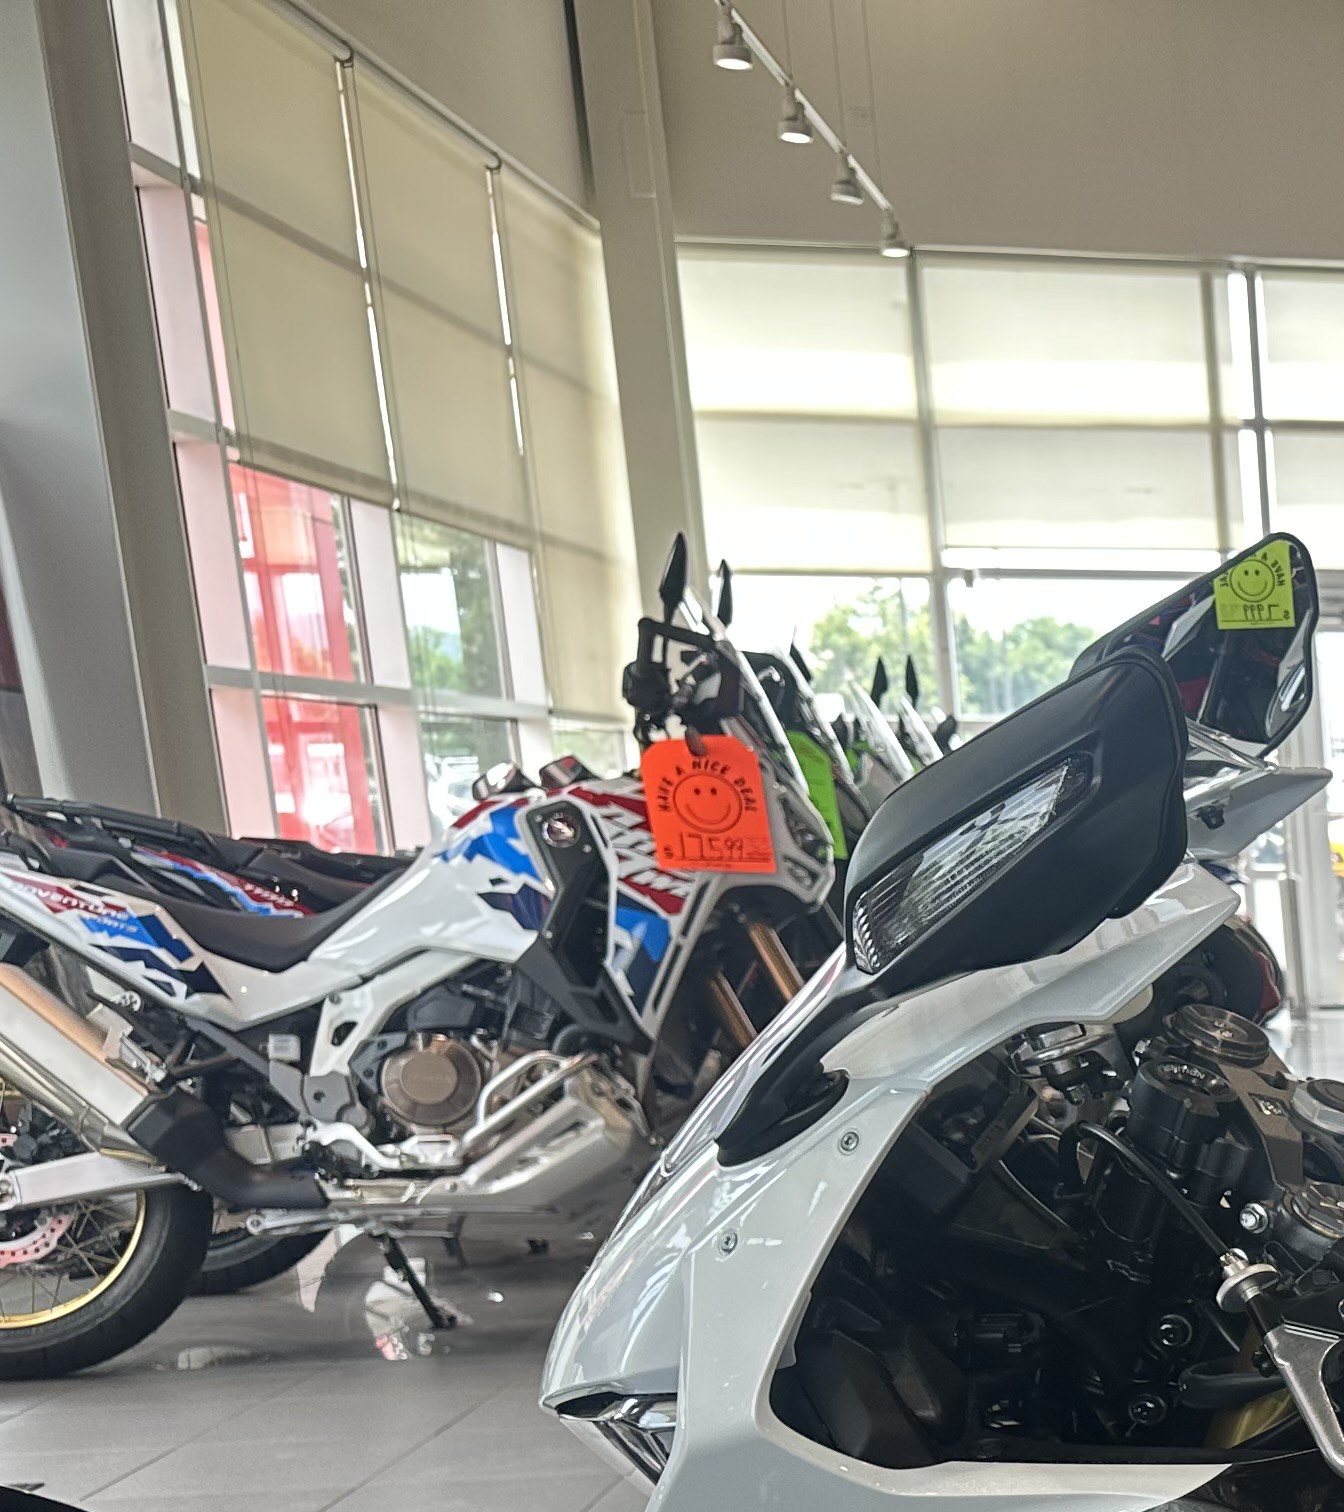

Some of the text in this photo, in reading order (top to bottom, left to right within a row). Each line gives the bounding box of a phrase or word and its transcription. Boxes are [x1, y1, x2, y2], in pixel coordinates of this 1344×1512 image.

[657, 776, 674, 812] HAVE
[676, 766, 685, 775] A
[691, 758, 731, 775] NICE
